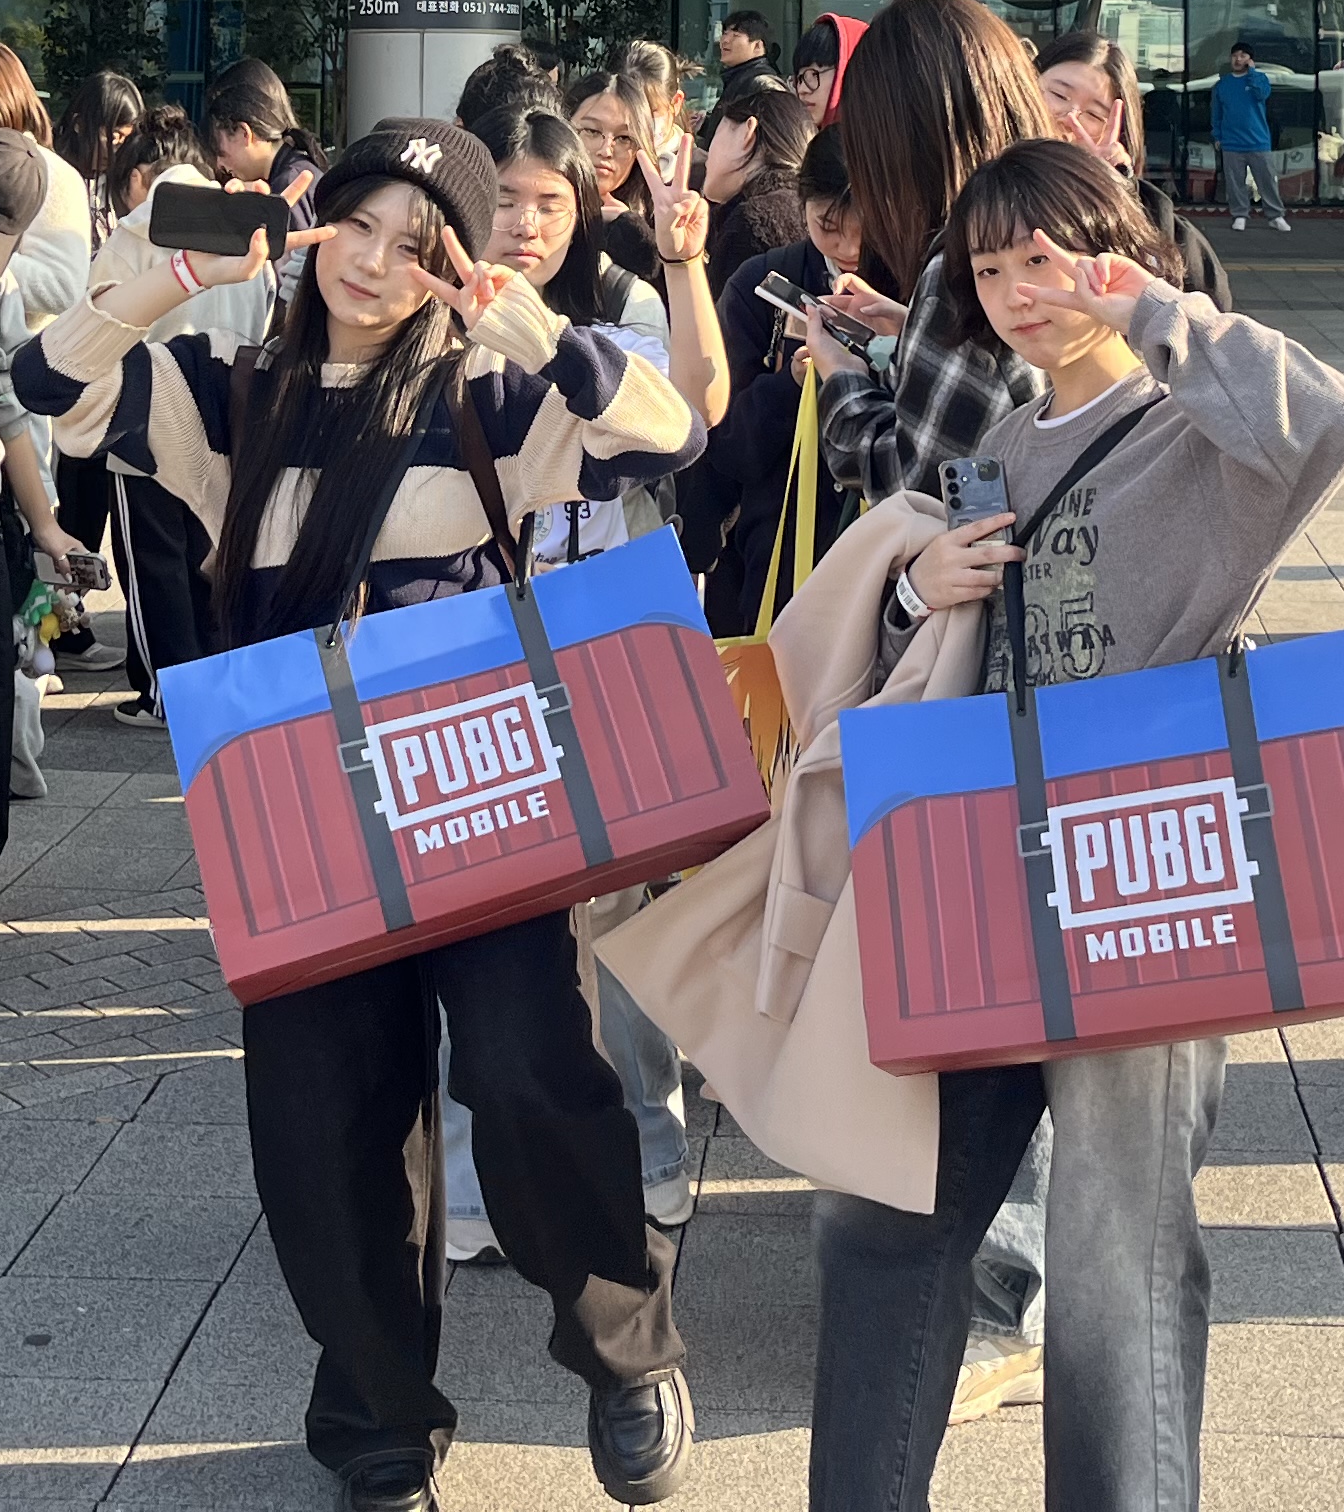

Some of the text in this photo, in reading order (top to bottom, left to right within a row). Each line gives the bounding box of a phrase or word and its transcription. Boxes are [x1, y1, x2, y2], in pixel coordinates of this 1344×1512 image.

[416, 0, 460, 14] 대표전화
[462, 1, 487, 15] 051)
[400, 137, 443, 174] NY
[390, 706, 535, 806] PUBG
[413, 790, 550, 855] MOBILE
[1072, 803, 1225, 903] PUBG
[1085, 913, 1237, 963] MOBILE
